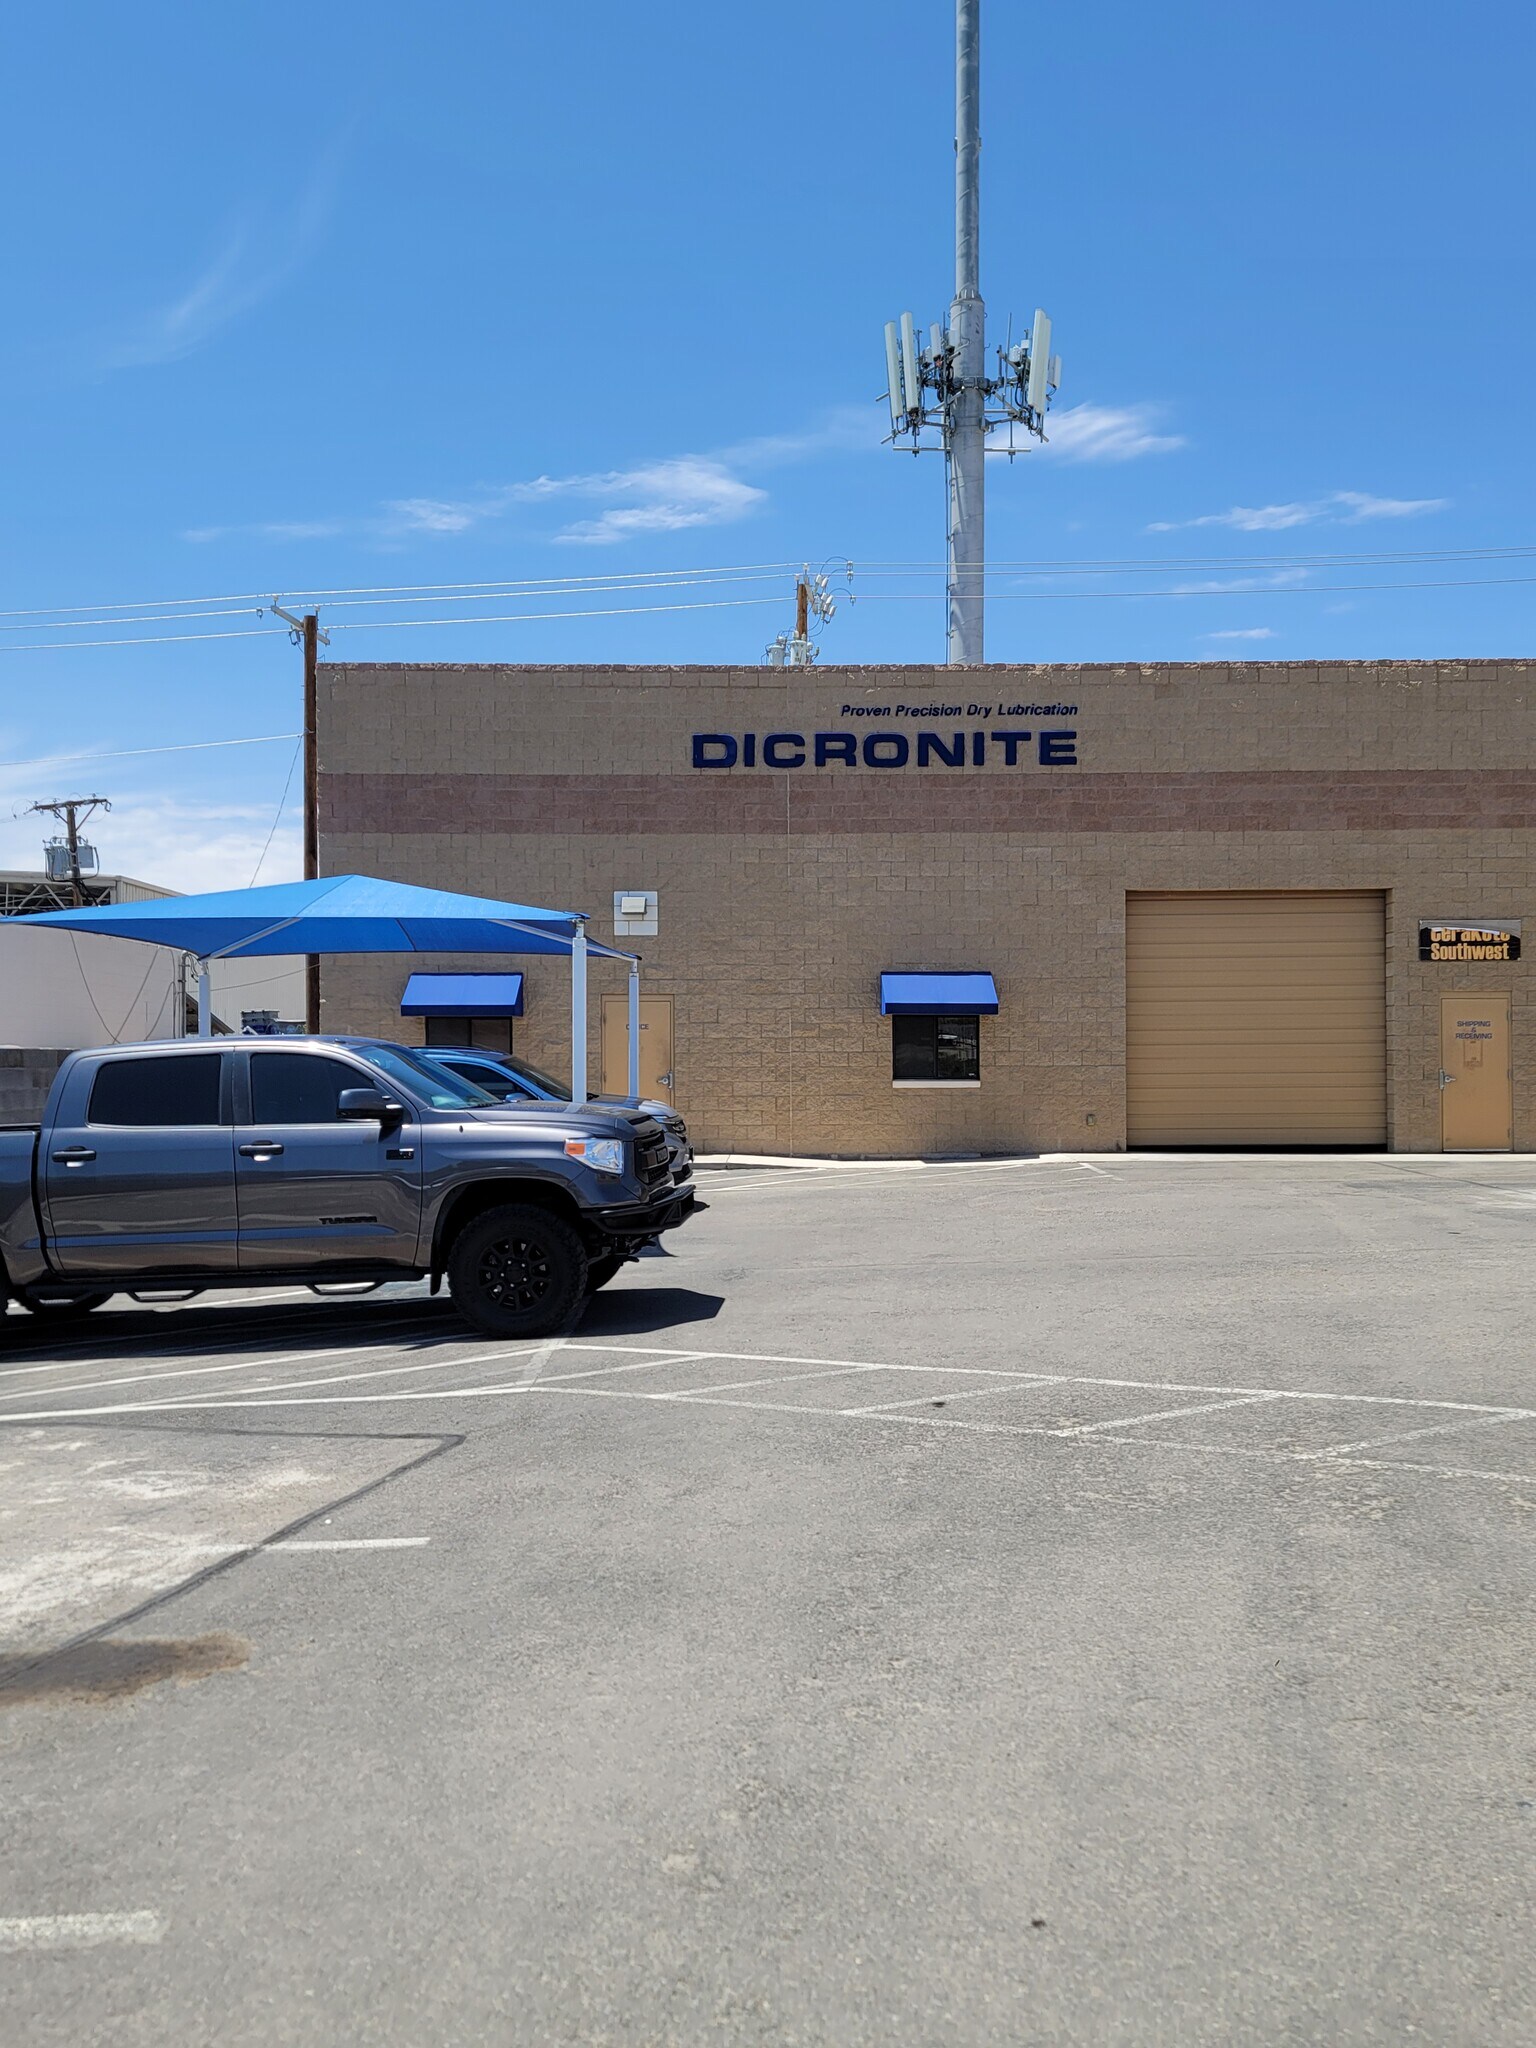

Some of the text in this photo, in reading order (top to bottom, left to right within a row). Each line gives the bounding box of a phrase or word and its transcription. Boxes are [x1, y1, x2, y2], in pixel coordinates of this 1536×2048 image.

[841, 703, 1078, 718] Proven Precision Dry Lubrication
[692, 731, 1077, 768] DICRONITE
[1430, 943, 1510, 960] Southwest
